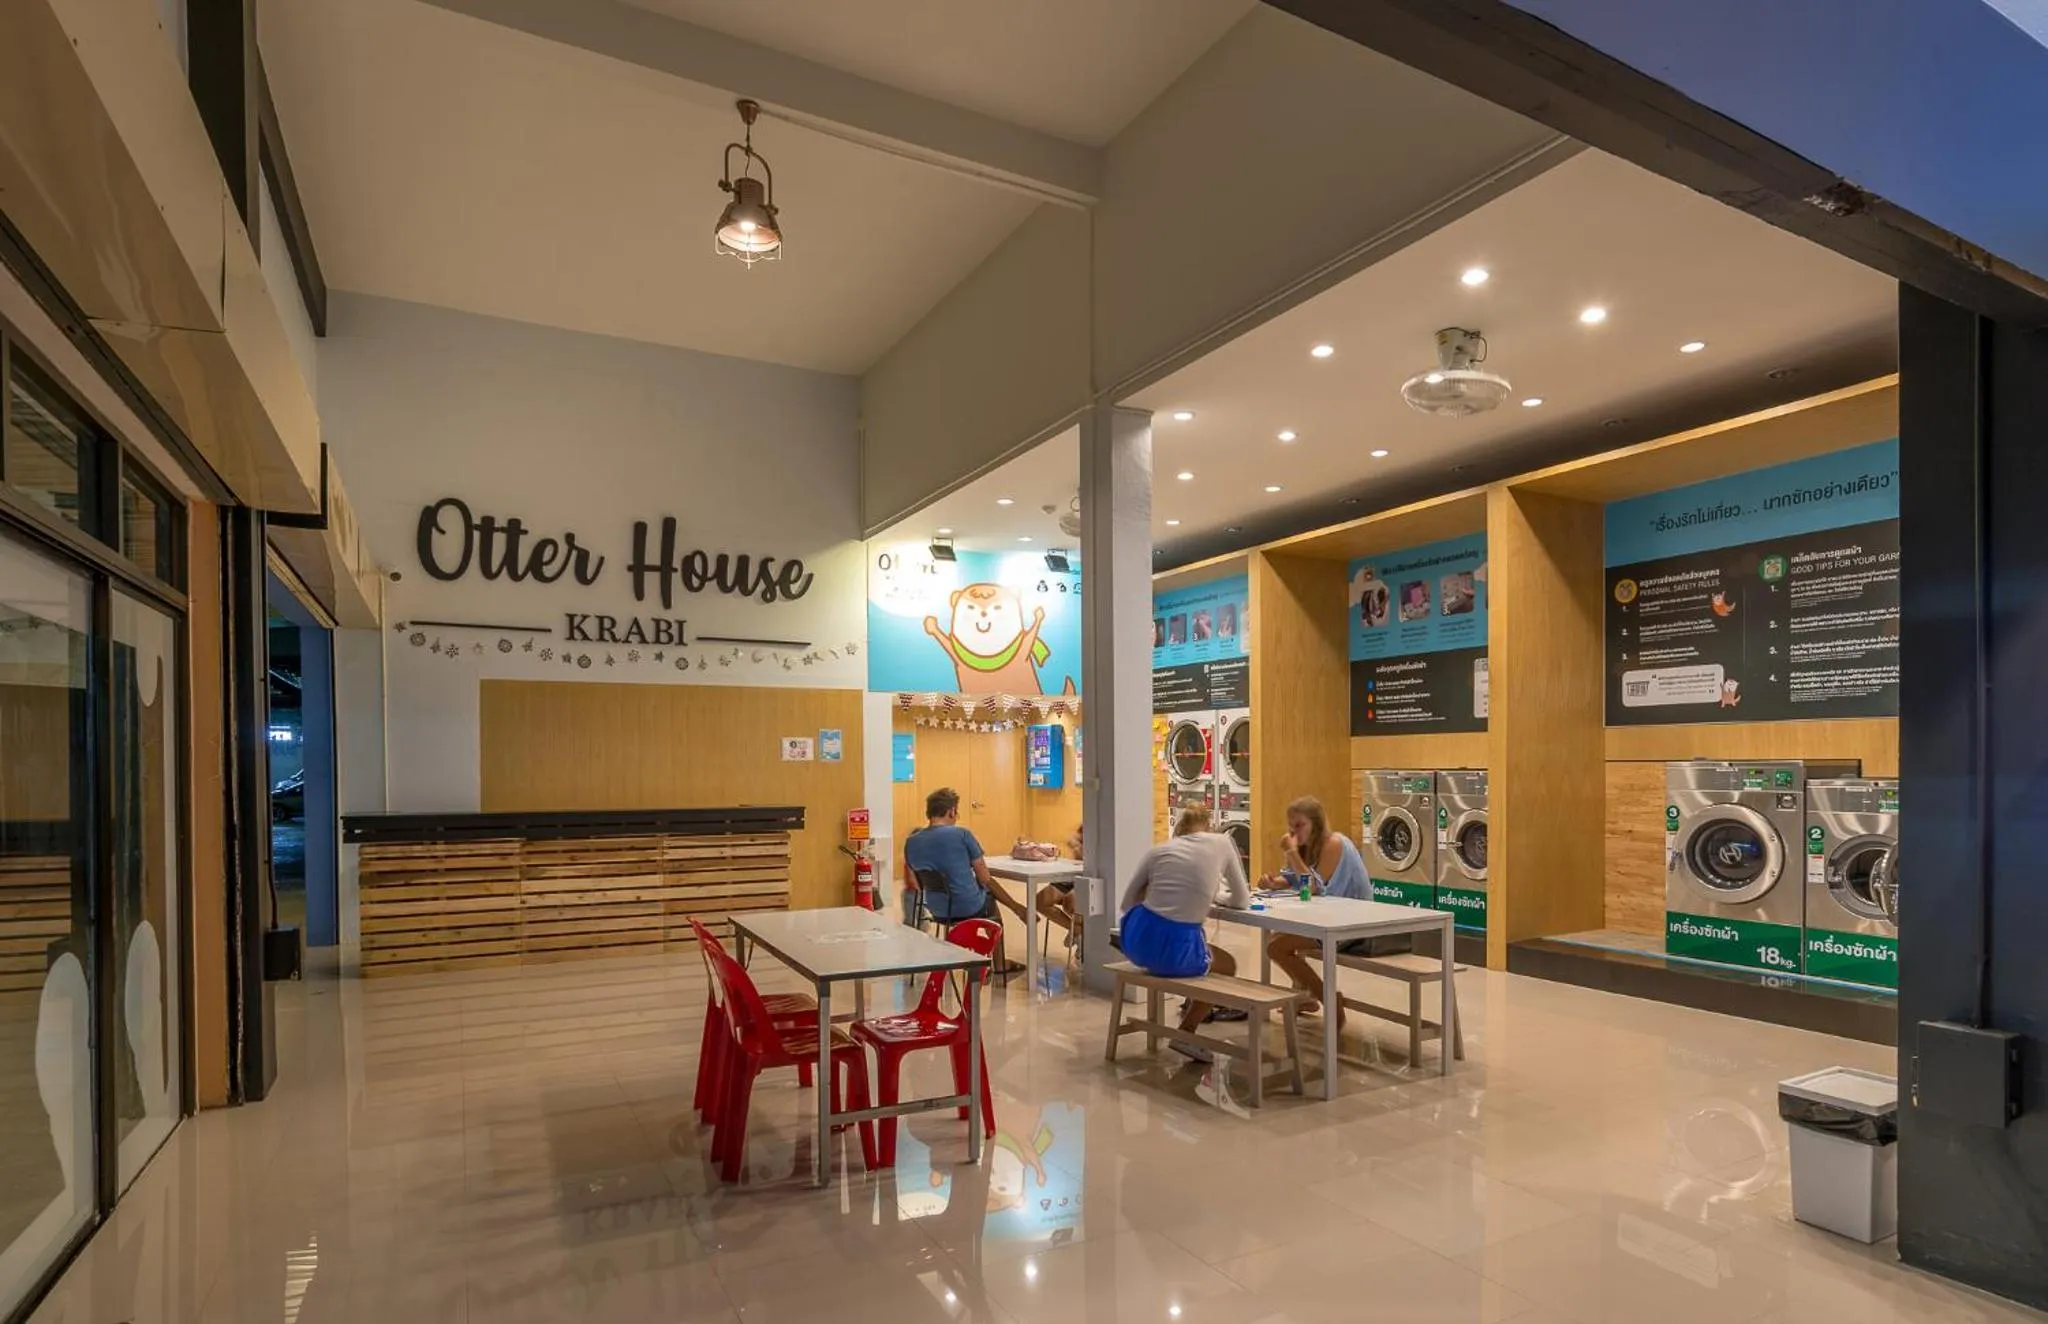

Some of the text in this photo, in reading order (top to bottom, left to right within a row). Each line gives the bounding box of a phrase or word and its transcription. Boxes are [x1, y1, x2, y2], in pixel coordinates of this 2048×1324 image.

[417, 497, 605, 587] Otter
[627, 516, 814, 610] House
[1791, 564, 1814, 574] GOOD
[1816, 562, 1833, 571] TIPS
[1835, 559, 1851, 569] FOR
[1853, 556, 1877, 566] YOUR
[1673, 582, 1697, 591] SAFETY
[565, 613, 688, 647] KRABI
[1669, 807, 1677, 817] 3
[1811, 828, 1822, 839] 2
[1670, 917, 1739, 941] เครื่องซักผ้า
[1809, 935, 1897, 961] เครื่องซักผ้า
